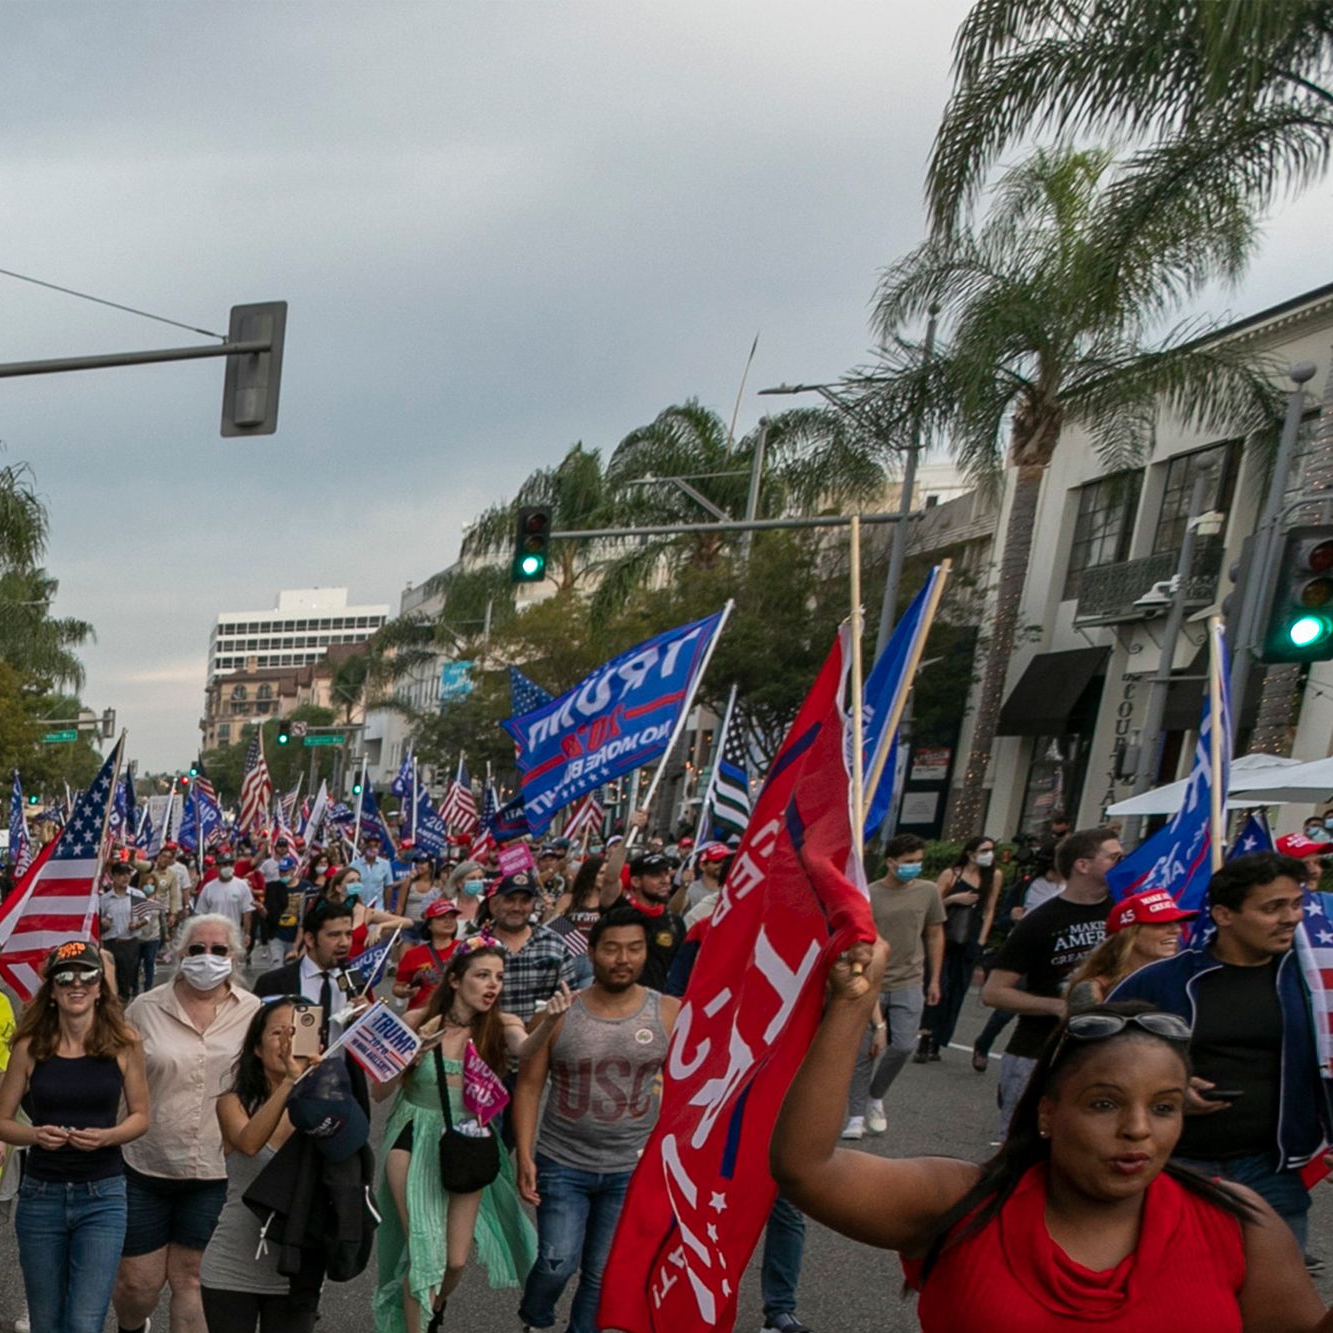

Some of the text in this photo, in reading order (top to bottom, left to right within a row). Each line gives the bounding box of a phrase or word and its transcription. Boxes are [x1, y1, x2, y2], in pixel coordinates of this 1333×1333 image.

[1119, 909, 1136, 925] 45
[368, 1034, 391, 1056] 2020
[371, 1011, 417, 1056] TRUMP
[557, 1056, 663, 1122] USC
